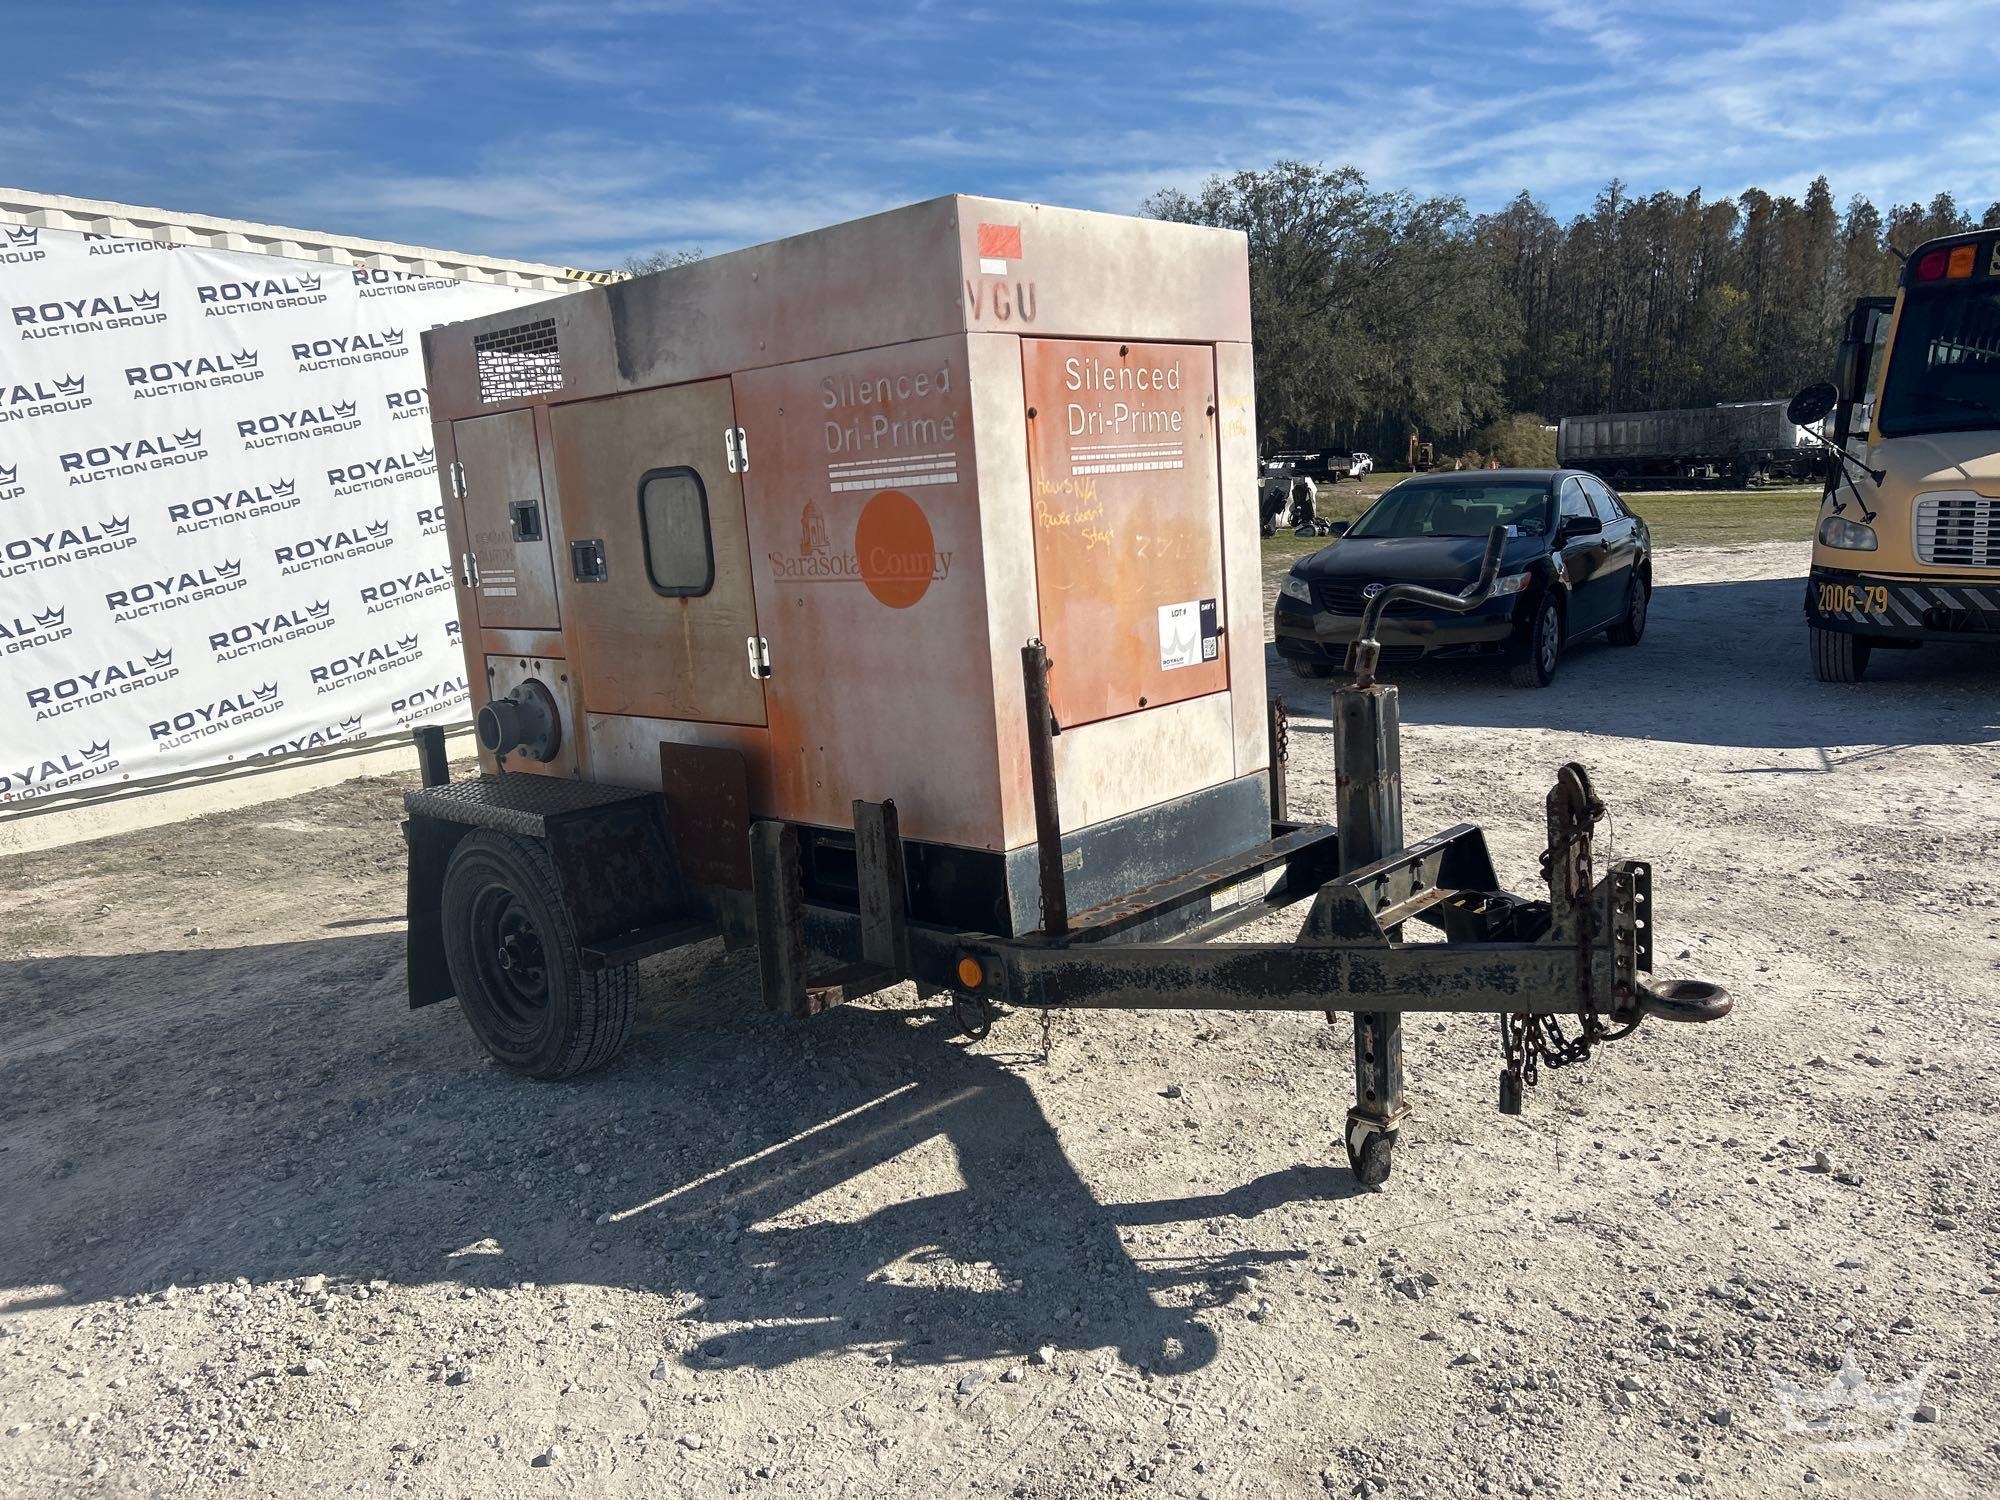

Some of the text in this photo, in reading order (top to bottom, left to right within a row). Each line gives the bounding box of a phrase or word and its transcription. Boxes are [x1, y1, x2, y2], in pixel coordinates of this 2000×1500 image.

[89, 241, 166, 255] AUCTION
[197, 278, 299, 303] ROYAL
[204, 295, 328, 317] AUCTION GROUP
[359, 280, 461, 298] AUCTION GROUP
[11, 295, 133, 326] ROYAL
[21, 313, 168, 341] AUCTION GROUP
[291, 334, 384, 361] ROYAL
[298, 347, 409, 373] AUCTION GROUP
[124, 355, 234, 386] ROYAL
[133, 370, 265, 400] AUCTION GROUP
[820, 359, 950, 410] Silenced
[1064, 357, 1181, 392] Silenced
[27, 398, 93, 418] GROUP
[236, 406, 335, 438] ROYAL
[392, 406, 430, 421] AUCTI
[1067, 402, 1182, 436] Dri-Prime
[243, 420, 362, 451] AUCTION GROUP
[824, 414, 956, 453] Dri-Prime
[59, 436, 177, 472] ROYAL
[69, 450, 209, 487] AUCTION GROUP
[327, 454, 415, 486] ROYAL
[334, 465, 439, 497] AUCTION GROUP
[168, 487, 273, 522] ROYAL
[176, 498, 301, 536] AUCTION GROUP
[0, 525, 103, 563] OYAL
[0, 537, 138, 579] UCTION GROUP
[274, 528, 368, 564] ROYAL
[281, 538, 394, 577] AUCTION GROUP
[870, 546, 952, 581] County
[105, 569, 217, 611] ROYAL
[114, 578, 248, 623] AUCTION GROUP
[360, 568, 444, 604] ROYAL
[366, 590, 424, 616] AUCTION
[1817, 582, 1889, 614] 2006-79
[209, 609, 308, 651] ROYAL
[1172, 609, 1182, 617] LOT
[6, 627, 73, 654] GROUP
[216, 618, 336, 663] AUCTION GROUP
[310, 643, 399, 684] ROYAL
[317, 650, 423, 696] AUCTION GROUP
[26, 660, 146, 709] ROYAL
[36, 668, 180, 722] AUCTION GROUP
[391, 676, 469, 715] ROYAL
[149, 693, 255, 740] ROYAL
[158, 700, 284, 753] AUCTION GROUP
[396, 699, 452, 726] AUCTION
[0, 754, 84, 793] YAL
[55, 760, 120, 789] GROUP
